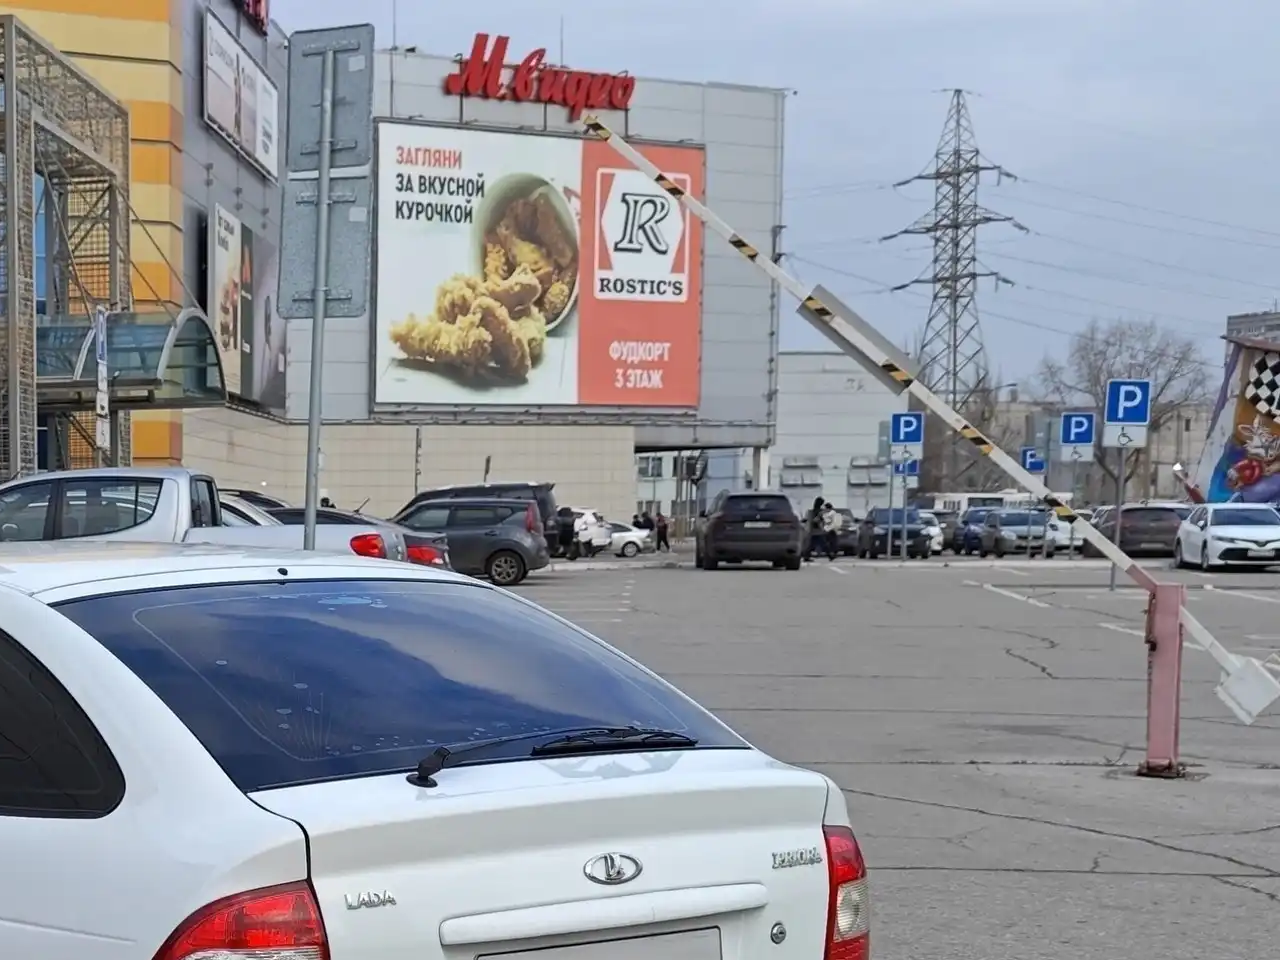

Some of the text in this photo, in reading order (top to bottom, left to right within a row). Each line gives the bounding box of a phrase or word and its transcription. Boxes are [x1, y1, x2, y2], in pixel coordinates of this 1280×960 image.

[395, 145, 462, 170] ЗАГЛЯНИ
[395, 172, 485, 198] ЗА ВКУСНОЙ
[395, 198, 474, 224] КУРОЧКОЙ
[613, 192, 670, 256] R
[598, 277, 684, 297] ROSTIC'S
[608, 340, 672, 364] ФУДКОРТ
[614, 368, 664, 390] 3 ЭТАЖ
[1117, 385, 1142, 419] P
[900, 416, 917, 440] P
[1065, 416, 1089, 441] P
[343, 889, 397, 911] LADA
